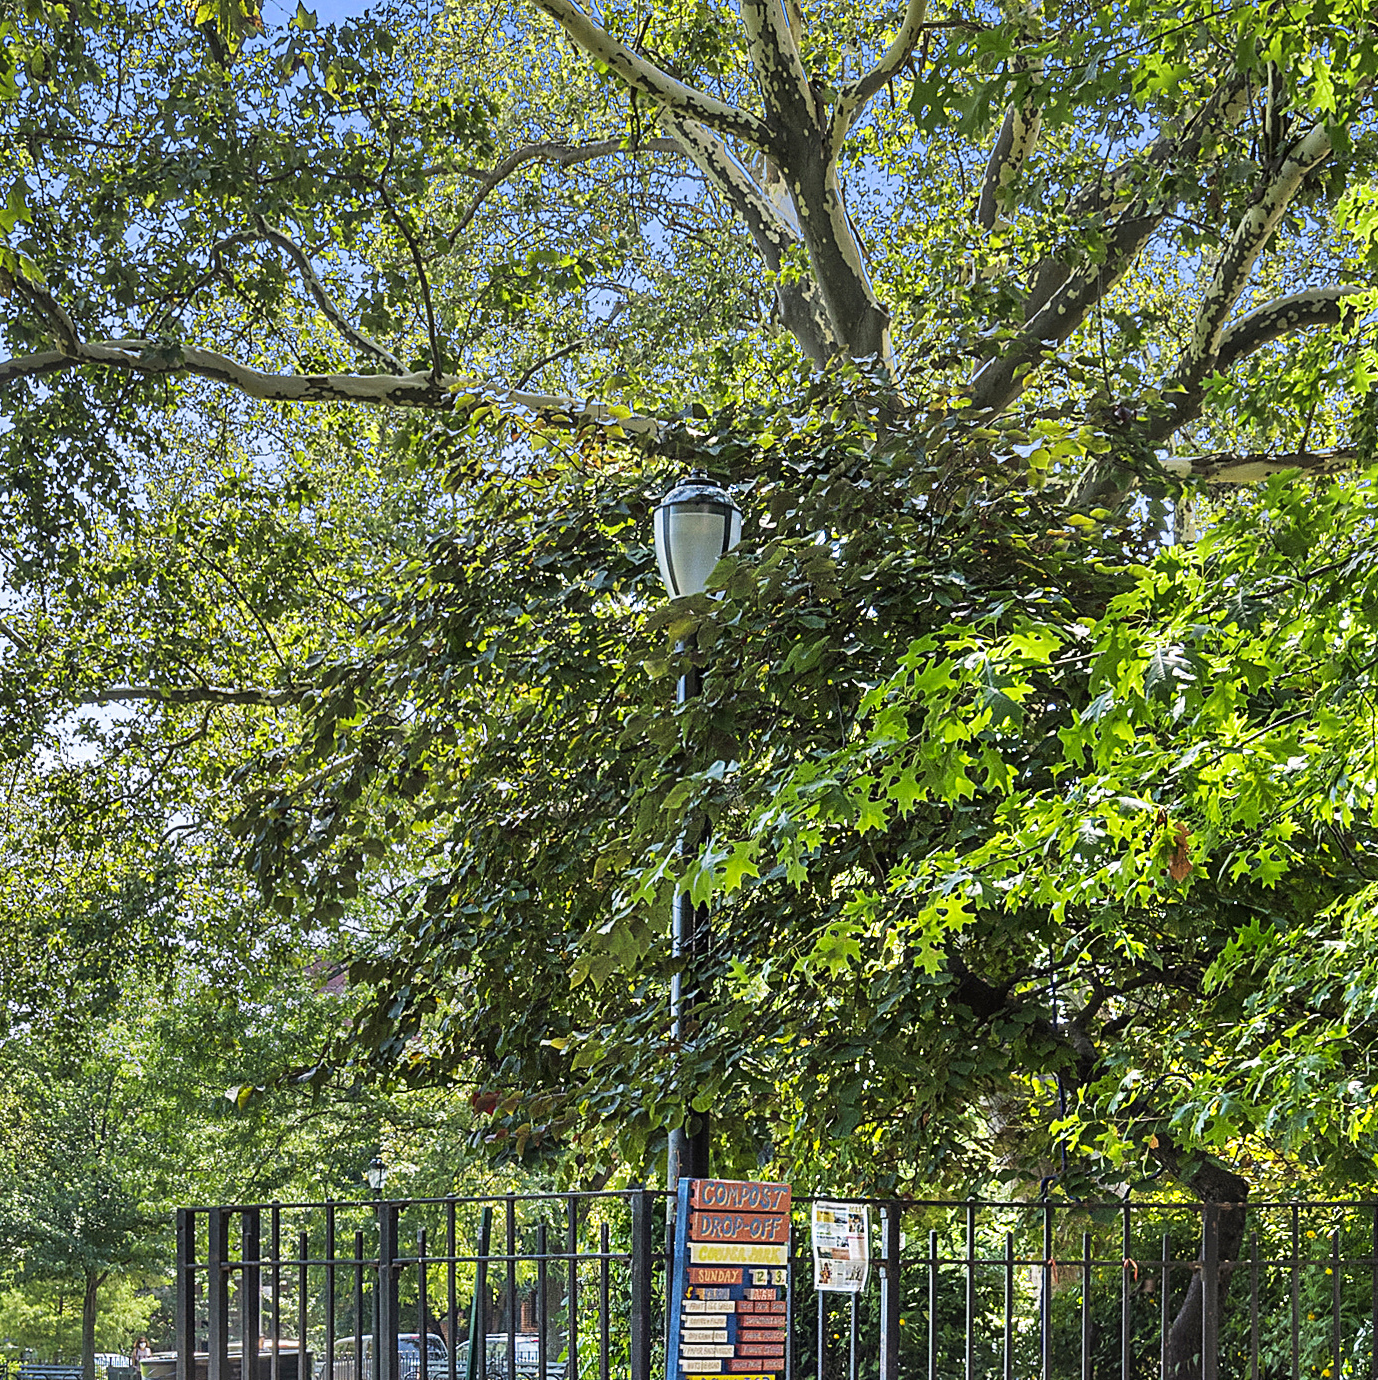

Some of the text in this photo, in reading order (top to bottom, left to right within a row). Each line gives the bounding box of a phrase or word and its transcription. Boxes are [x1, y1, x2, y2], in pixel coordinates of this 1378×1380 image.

[702, 1182, 788, 1210] COMPOST
[701, 1215, 783, 1241] DROP-OFF
[698, 1269, 739, 1283] SUNDAY
